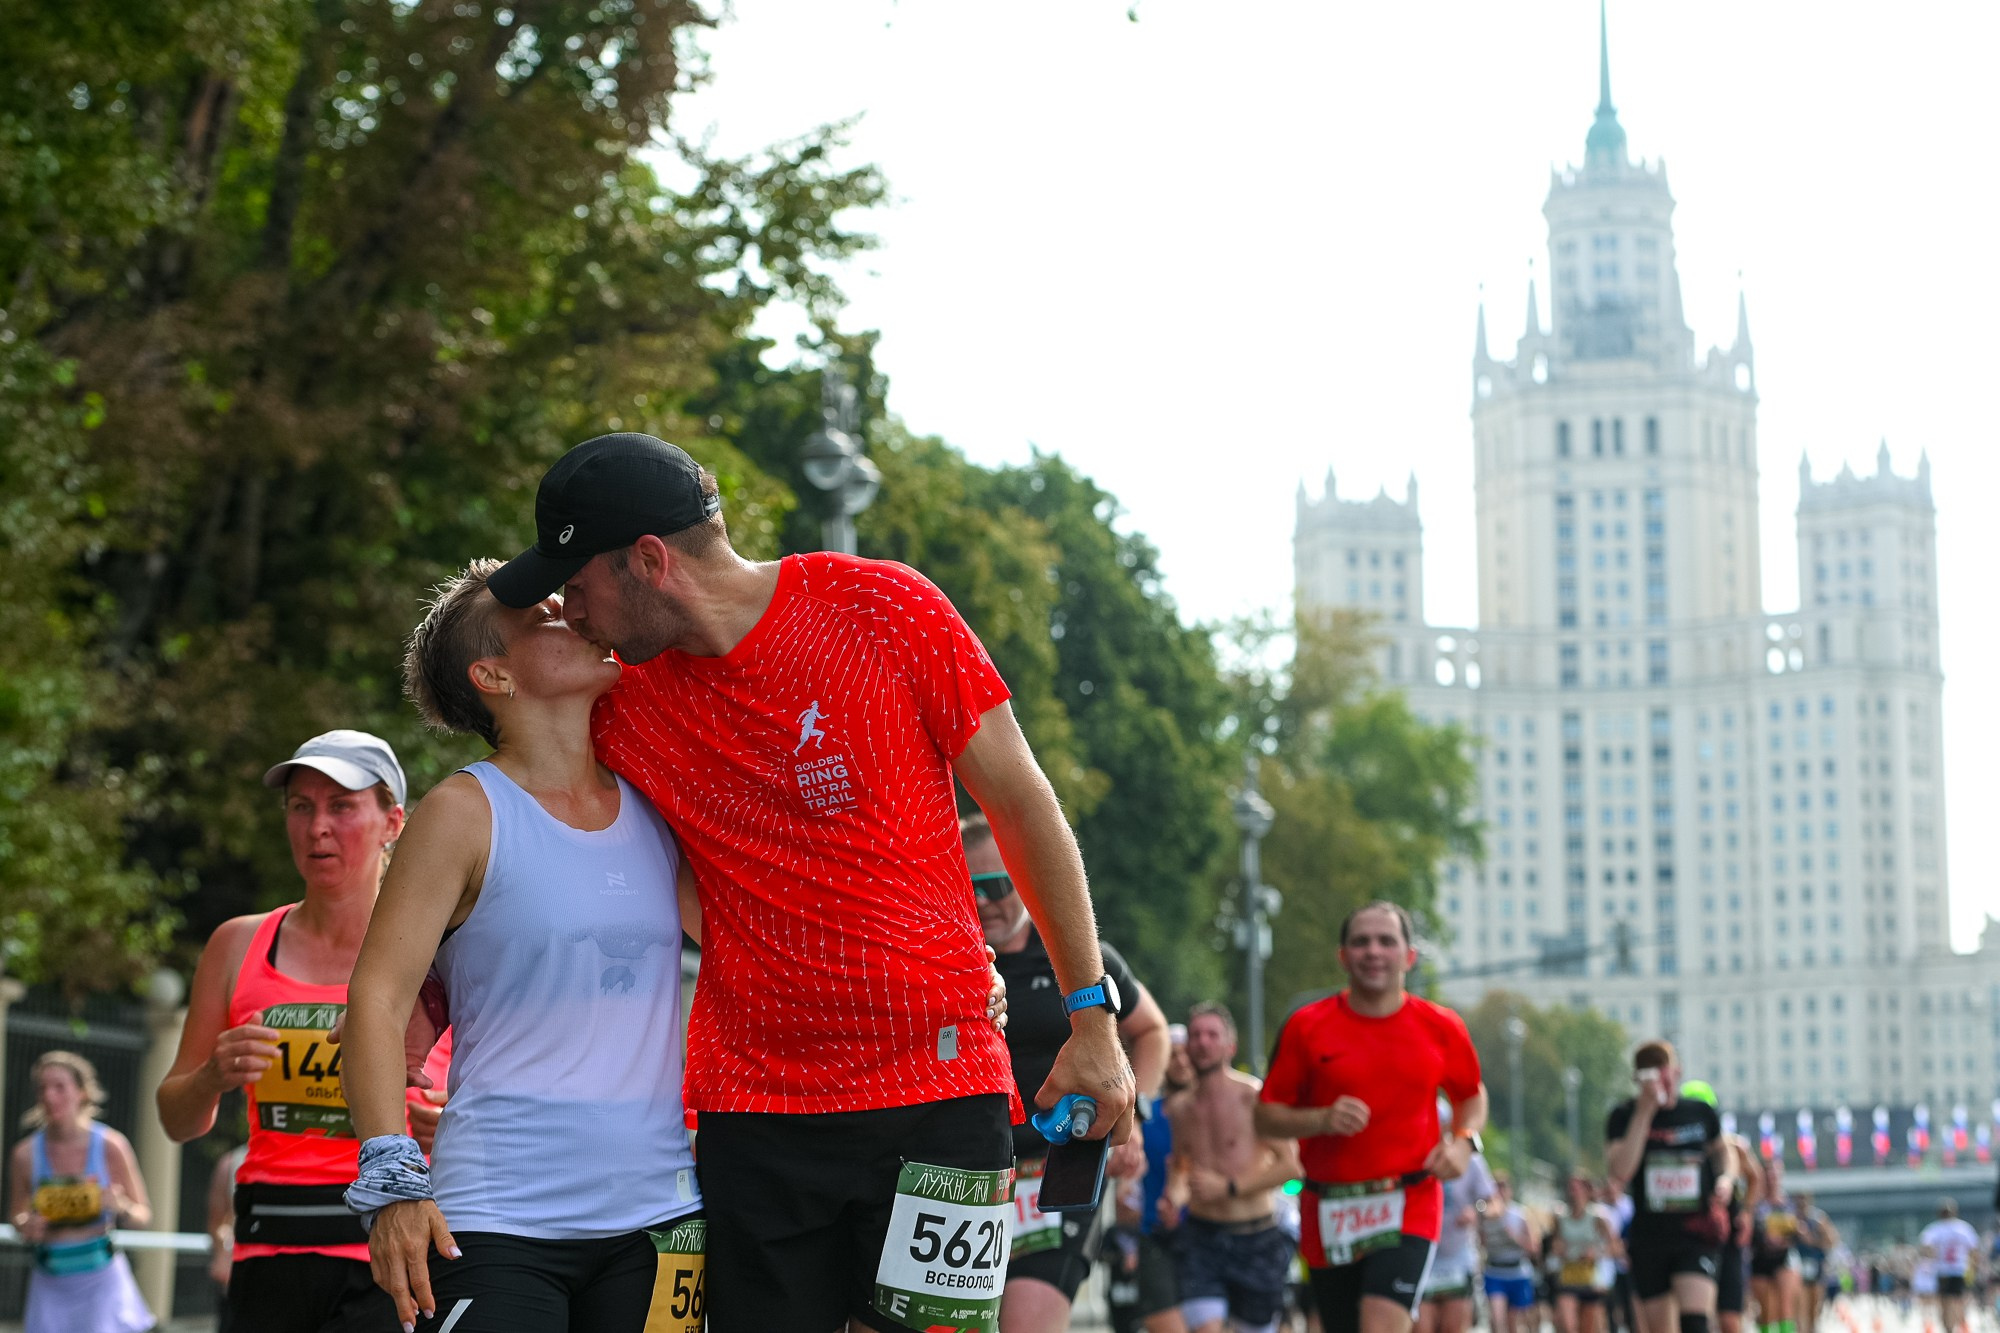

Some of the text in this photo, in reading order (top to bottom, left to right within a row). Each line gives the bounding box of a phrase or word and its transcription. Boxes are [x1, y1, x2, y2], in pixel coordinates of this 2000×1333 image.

[795, 754, 844, 773] GOLDEN
[797, 764, 849, 788] RING
[801, 780, 852, 799] ULTRA
[805, 792, 856, 810] TRAIL
[825, 807, 842, 817] 100
[271, 1105, 288, 1128] E
[910, 1212, 1003, 1269] 5620
[925, 1270, 994, 1291] ВСЕВОЛОД
[890, 1293, 911, 1319] E
